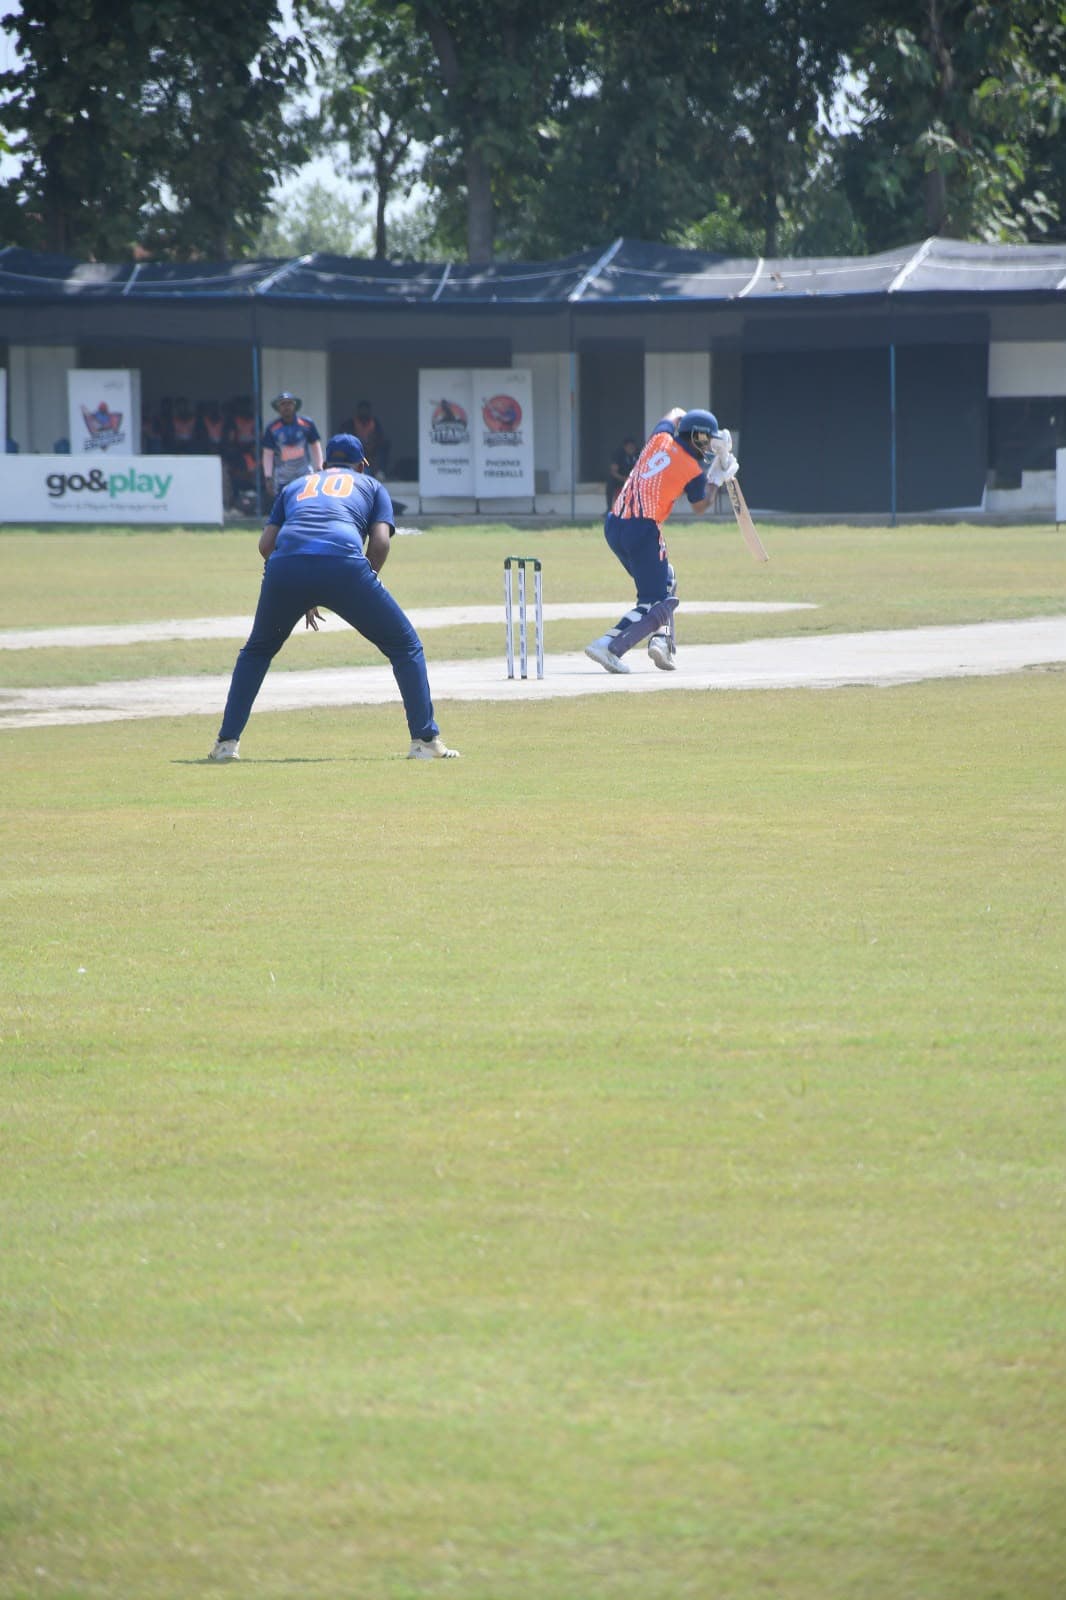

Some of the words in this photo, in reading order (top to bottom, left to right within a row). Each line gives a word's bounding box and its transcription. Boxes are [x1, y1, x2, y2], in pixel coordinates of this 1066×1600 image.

[640, 451, 672, 480] 9
[46, 468, 173, 499] go&play
[297, 473, 354, 501] 10
